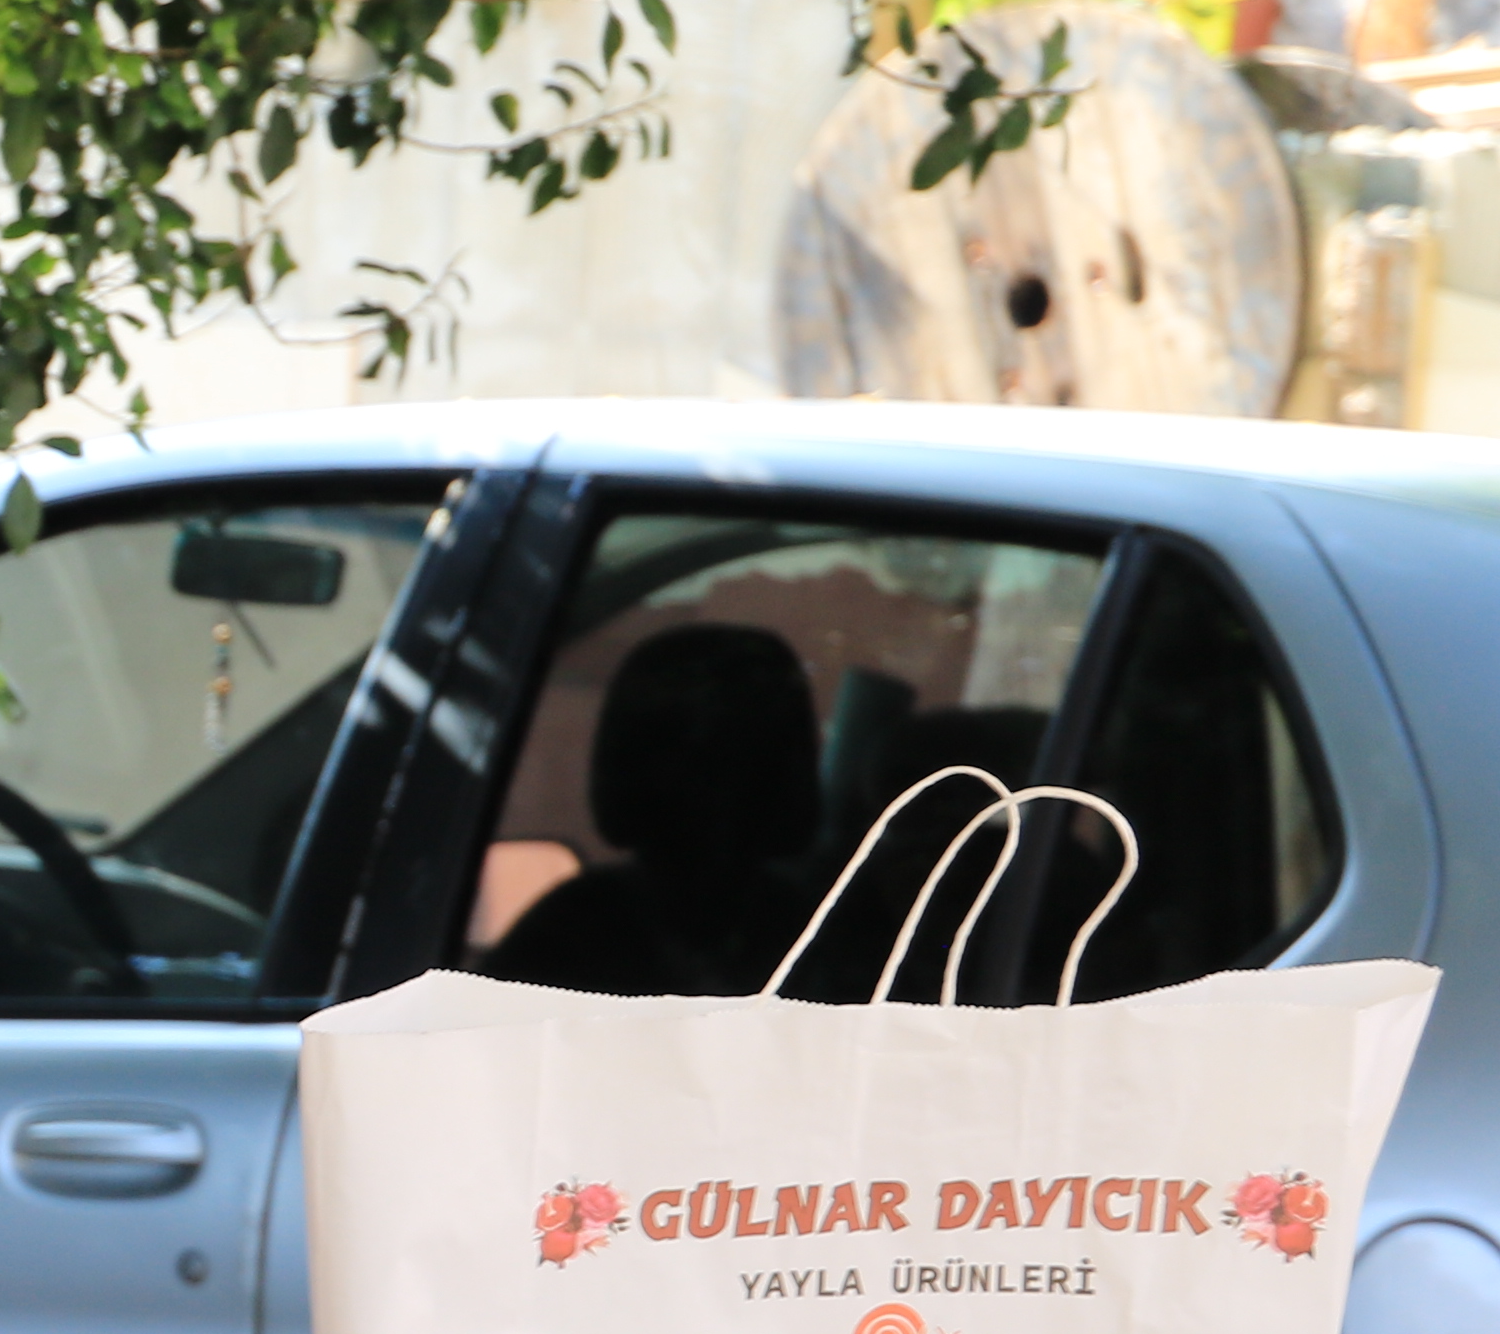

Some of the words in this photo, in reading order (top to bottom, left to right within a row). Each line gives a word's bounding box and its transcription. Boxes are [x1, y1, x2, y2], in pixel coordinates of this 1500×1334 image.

[640, 1178, 911, 1242] GÜLNAR
[935, 1175, 1215, 1236] DAYICIK
[739, 1267, 863, 1300] YAYLA
[891, 1257, 1097, 1296] ÜRÜNLERİ
